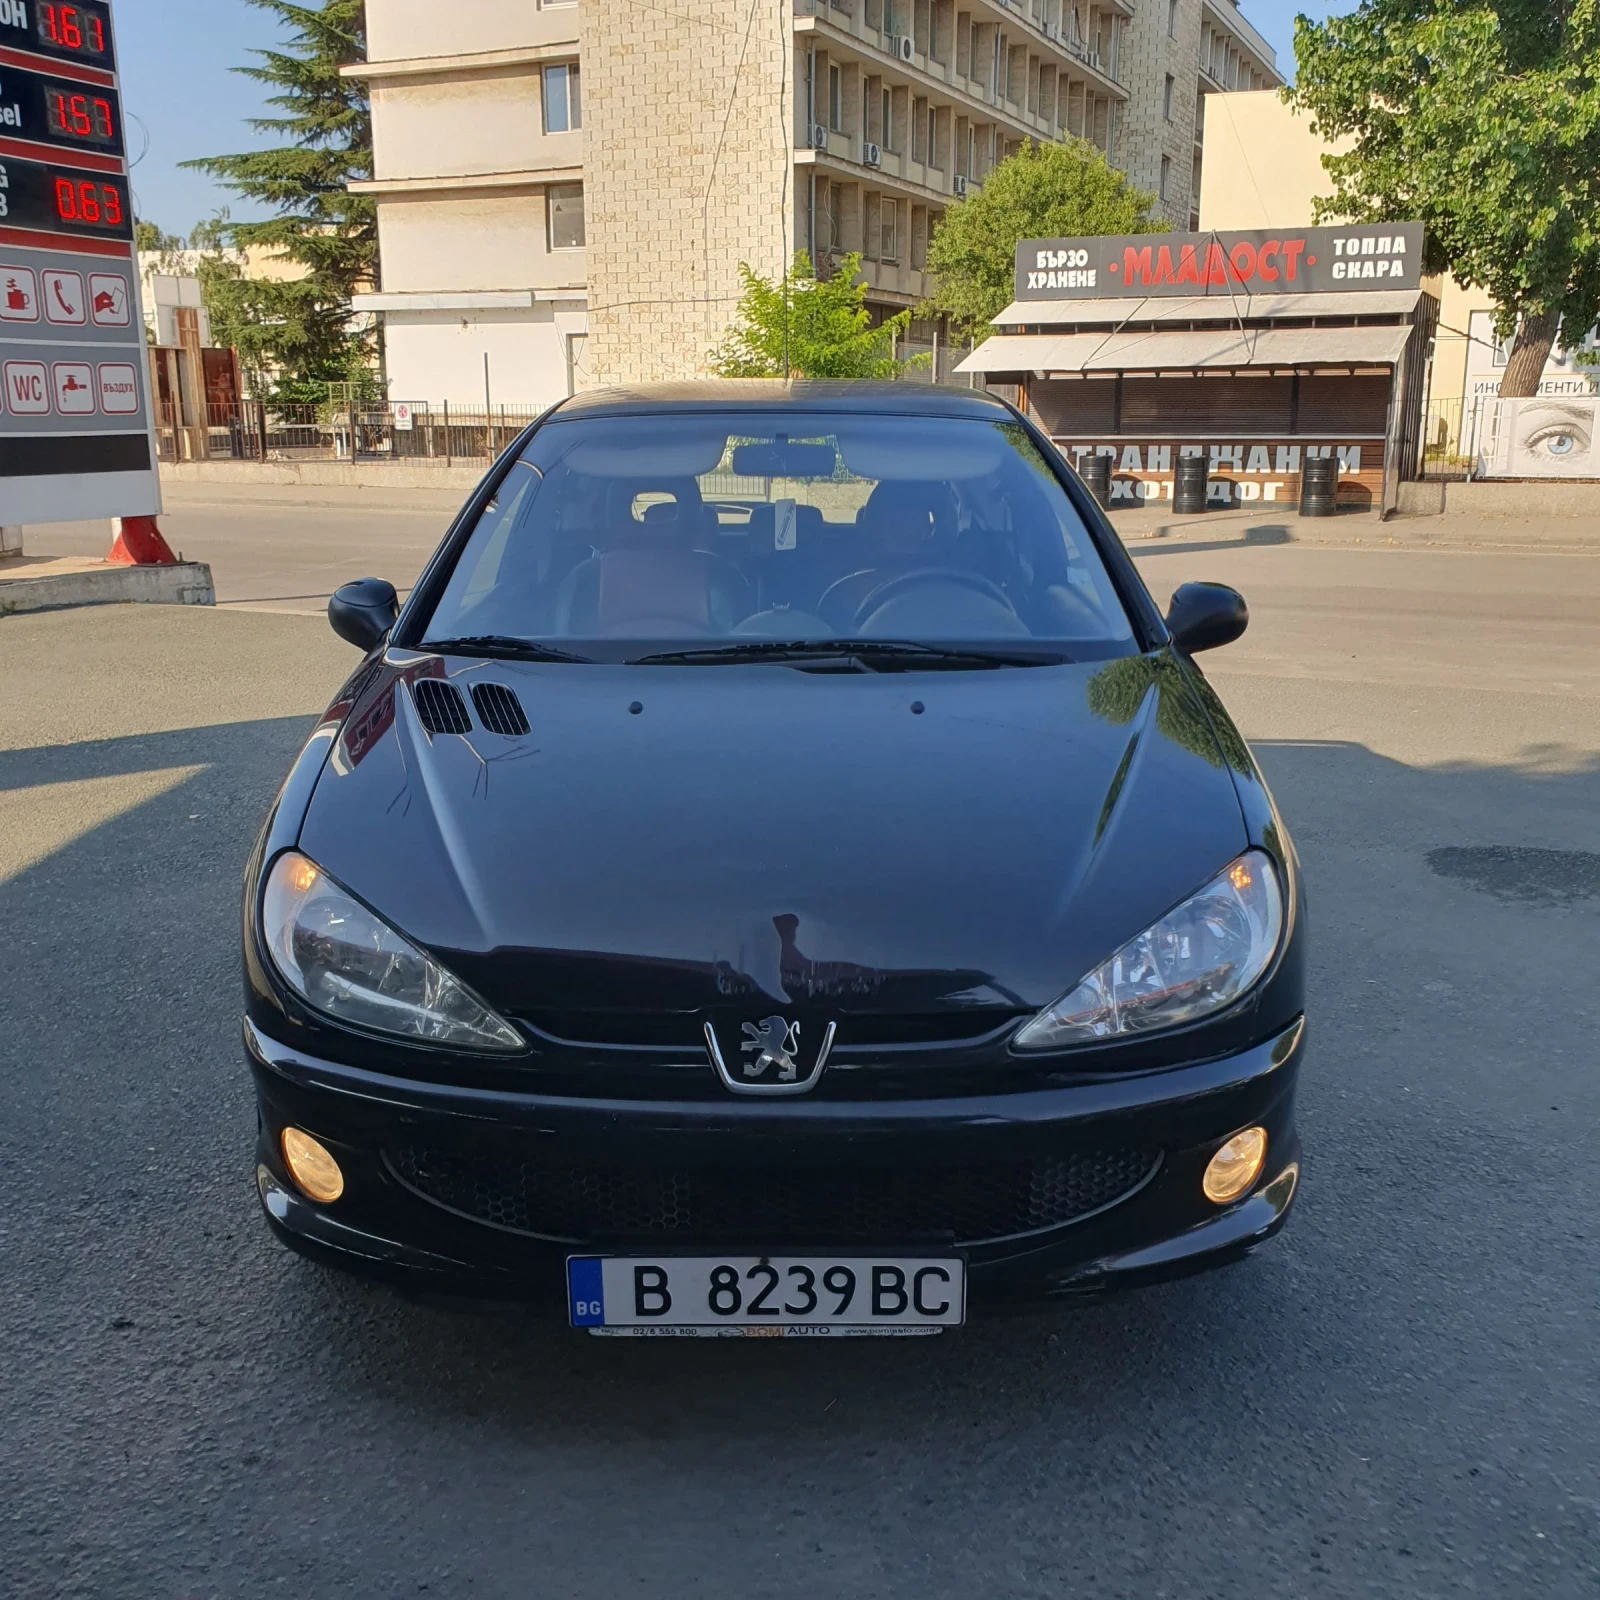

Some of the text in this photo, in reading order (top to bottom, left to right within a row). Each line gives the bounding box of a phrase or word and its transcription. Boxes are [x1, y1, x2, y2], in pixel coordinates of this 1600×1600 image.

[48, 5, 104, 51] 1.61
[58, 95, 112, 137] 1.57
[55, 178, 122, 225] 0.63
[1333, 236, 1406, 256] ТОПЛА
[1036, 249, 1089, 269] БЪРЗО
[1123, 239, 1306, 286] МЛАДОСТ
[1332, 259, 1404, 280] СКАРА
[1027, 269, 1096, 289] ХРАНЕНЕ
[13, 374, 42, 402] WC
[103, 383, 135, 393] ВЪЗДУХ
[633, 1265, 951, 1317] B 8239 BC
[575, 1300, 601, 1316] BG
[787, 1326, 831, 1336] AUTO
